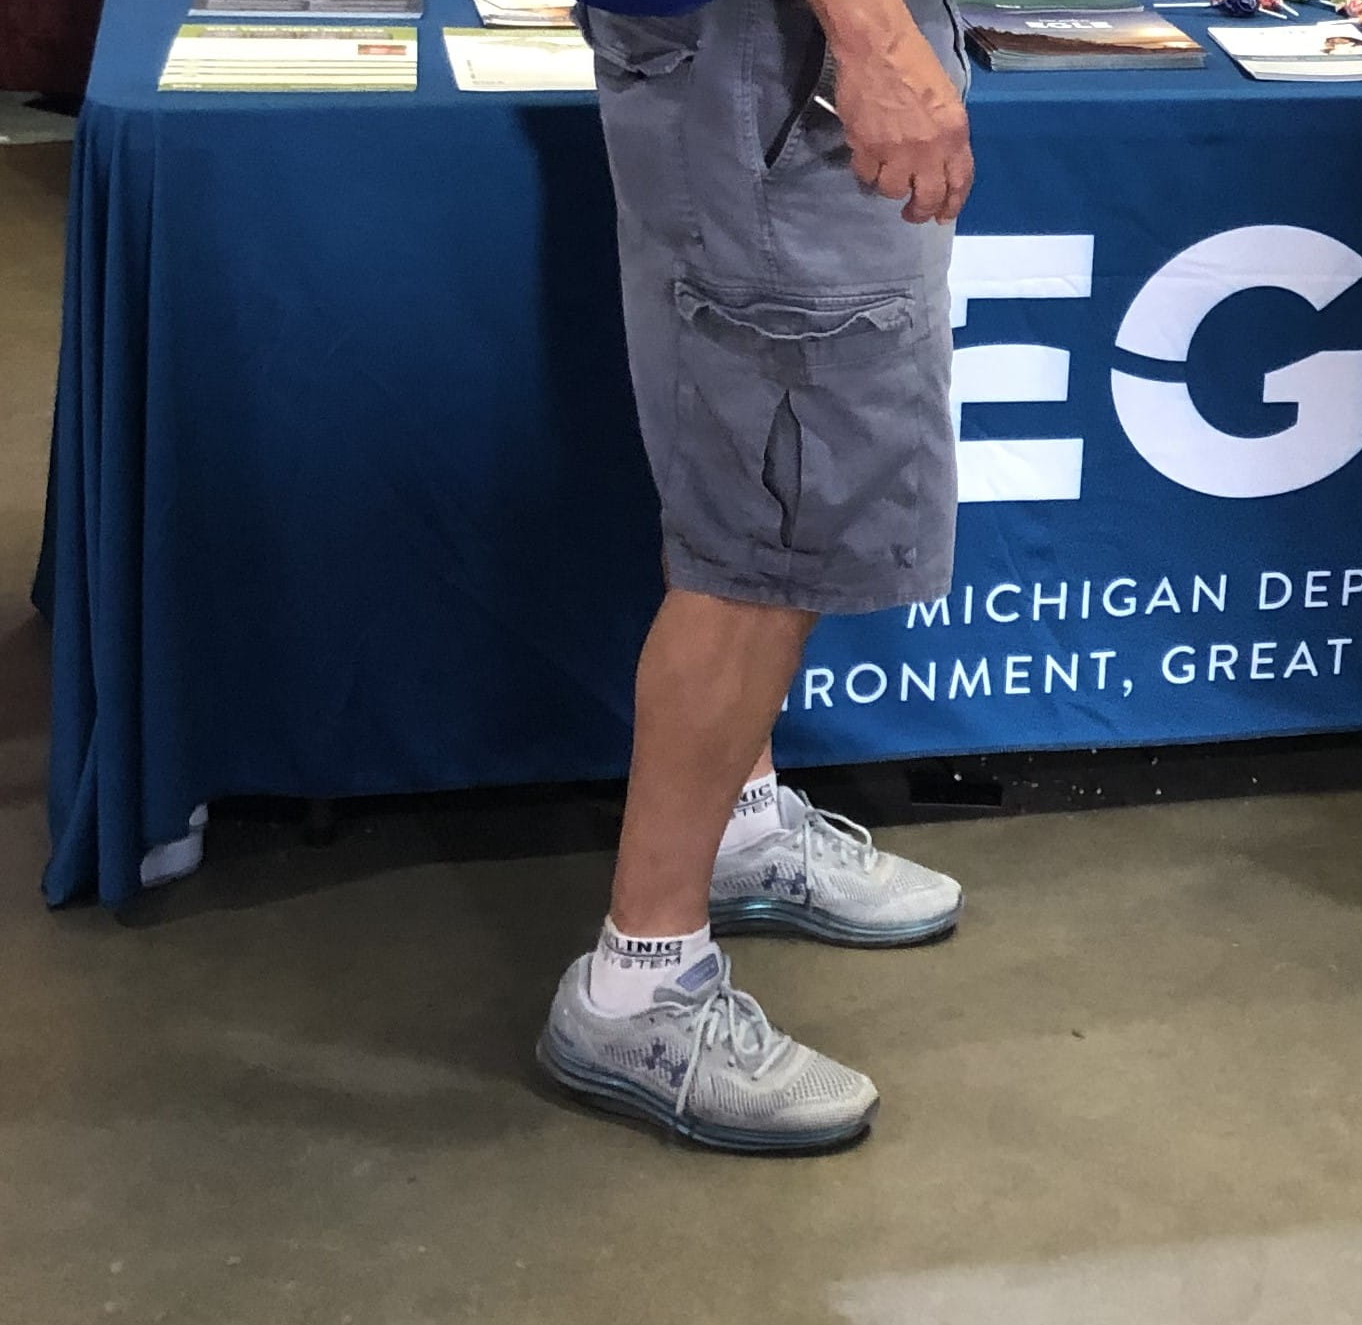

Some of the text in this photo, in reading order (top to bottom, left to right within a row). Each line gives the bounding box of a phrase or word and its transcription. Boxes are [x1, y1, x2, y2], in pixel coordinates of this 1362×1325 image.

[907, 574, 1228, 629] MICHIGAN
[780, 651, 1134, 712] RONMENT,
[1161, 638, 1352, 685] GREAT
